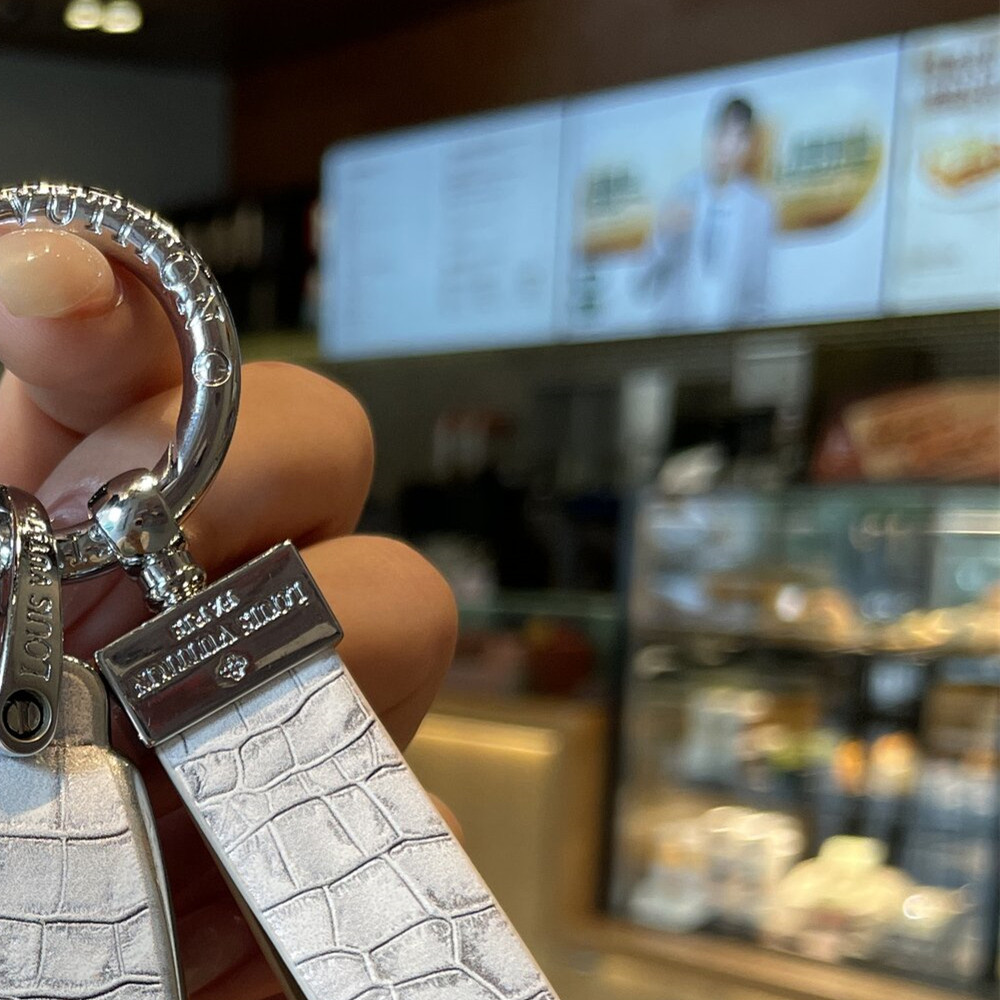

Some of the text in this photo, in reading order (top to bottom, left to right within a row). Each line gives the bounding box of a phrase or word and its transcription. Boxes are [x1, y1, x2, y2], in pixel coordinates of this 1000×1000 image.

[1, 182, 225, 330] VUITTON
[19, 594, 53, 682] LOUIS
[238, 581, 308, 636] LOUIS
